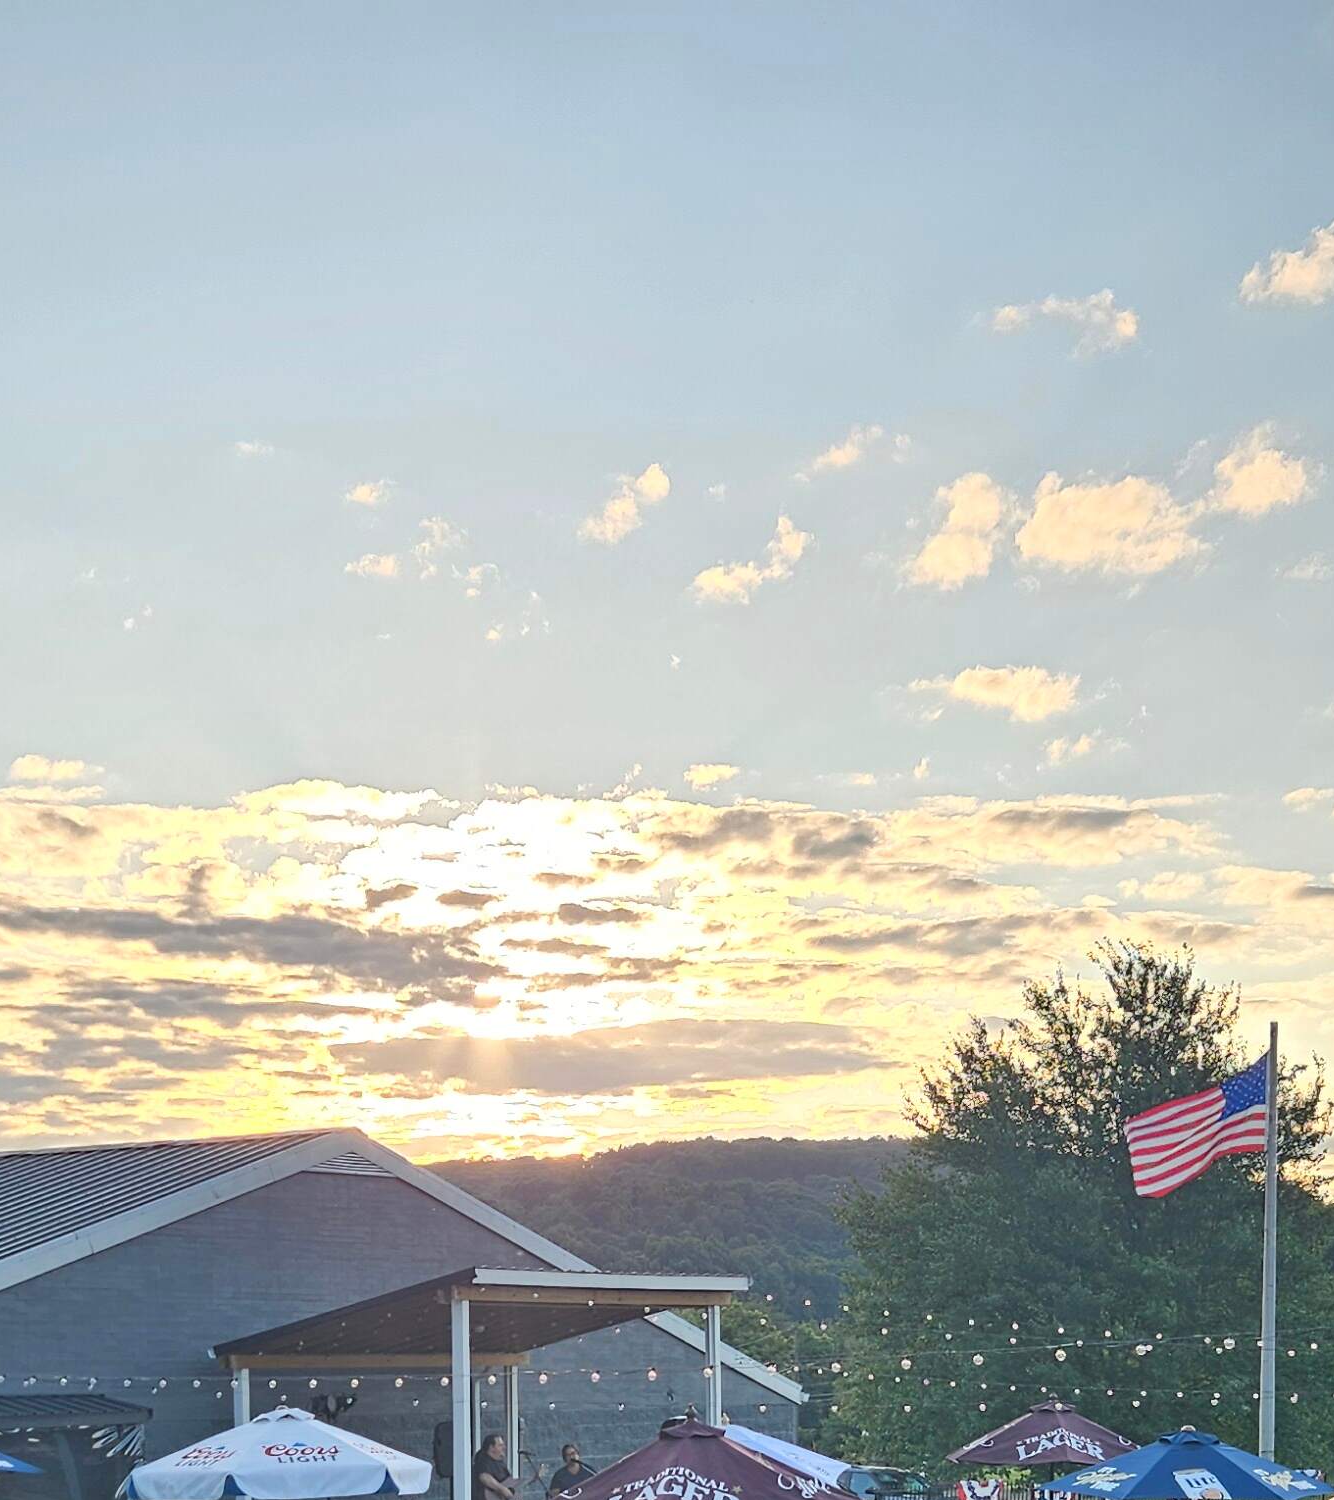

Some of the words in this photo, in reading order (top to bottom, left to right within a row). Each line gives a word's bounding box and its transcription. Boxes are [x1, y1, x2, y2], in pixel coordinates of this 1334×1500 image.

[261, 1443, 339, 1457] Coors
[1016, 1432, 1106, 1461] LAGER
[278, 1454, 337, 1464] LIGHT
[623, 1466, 729, 1493] TRADITIONAL
